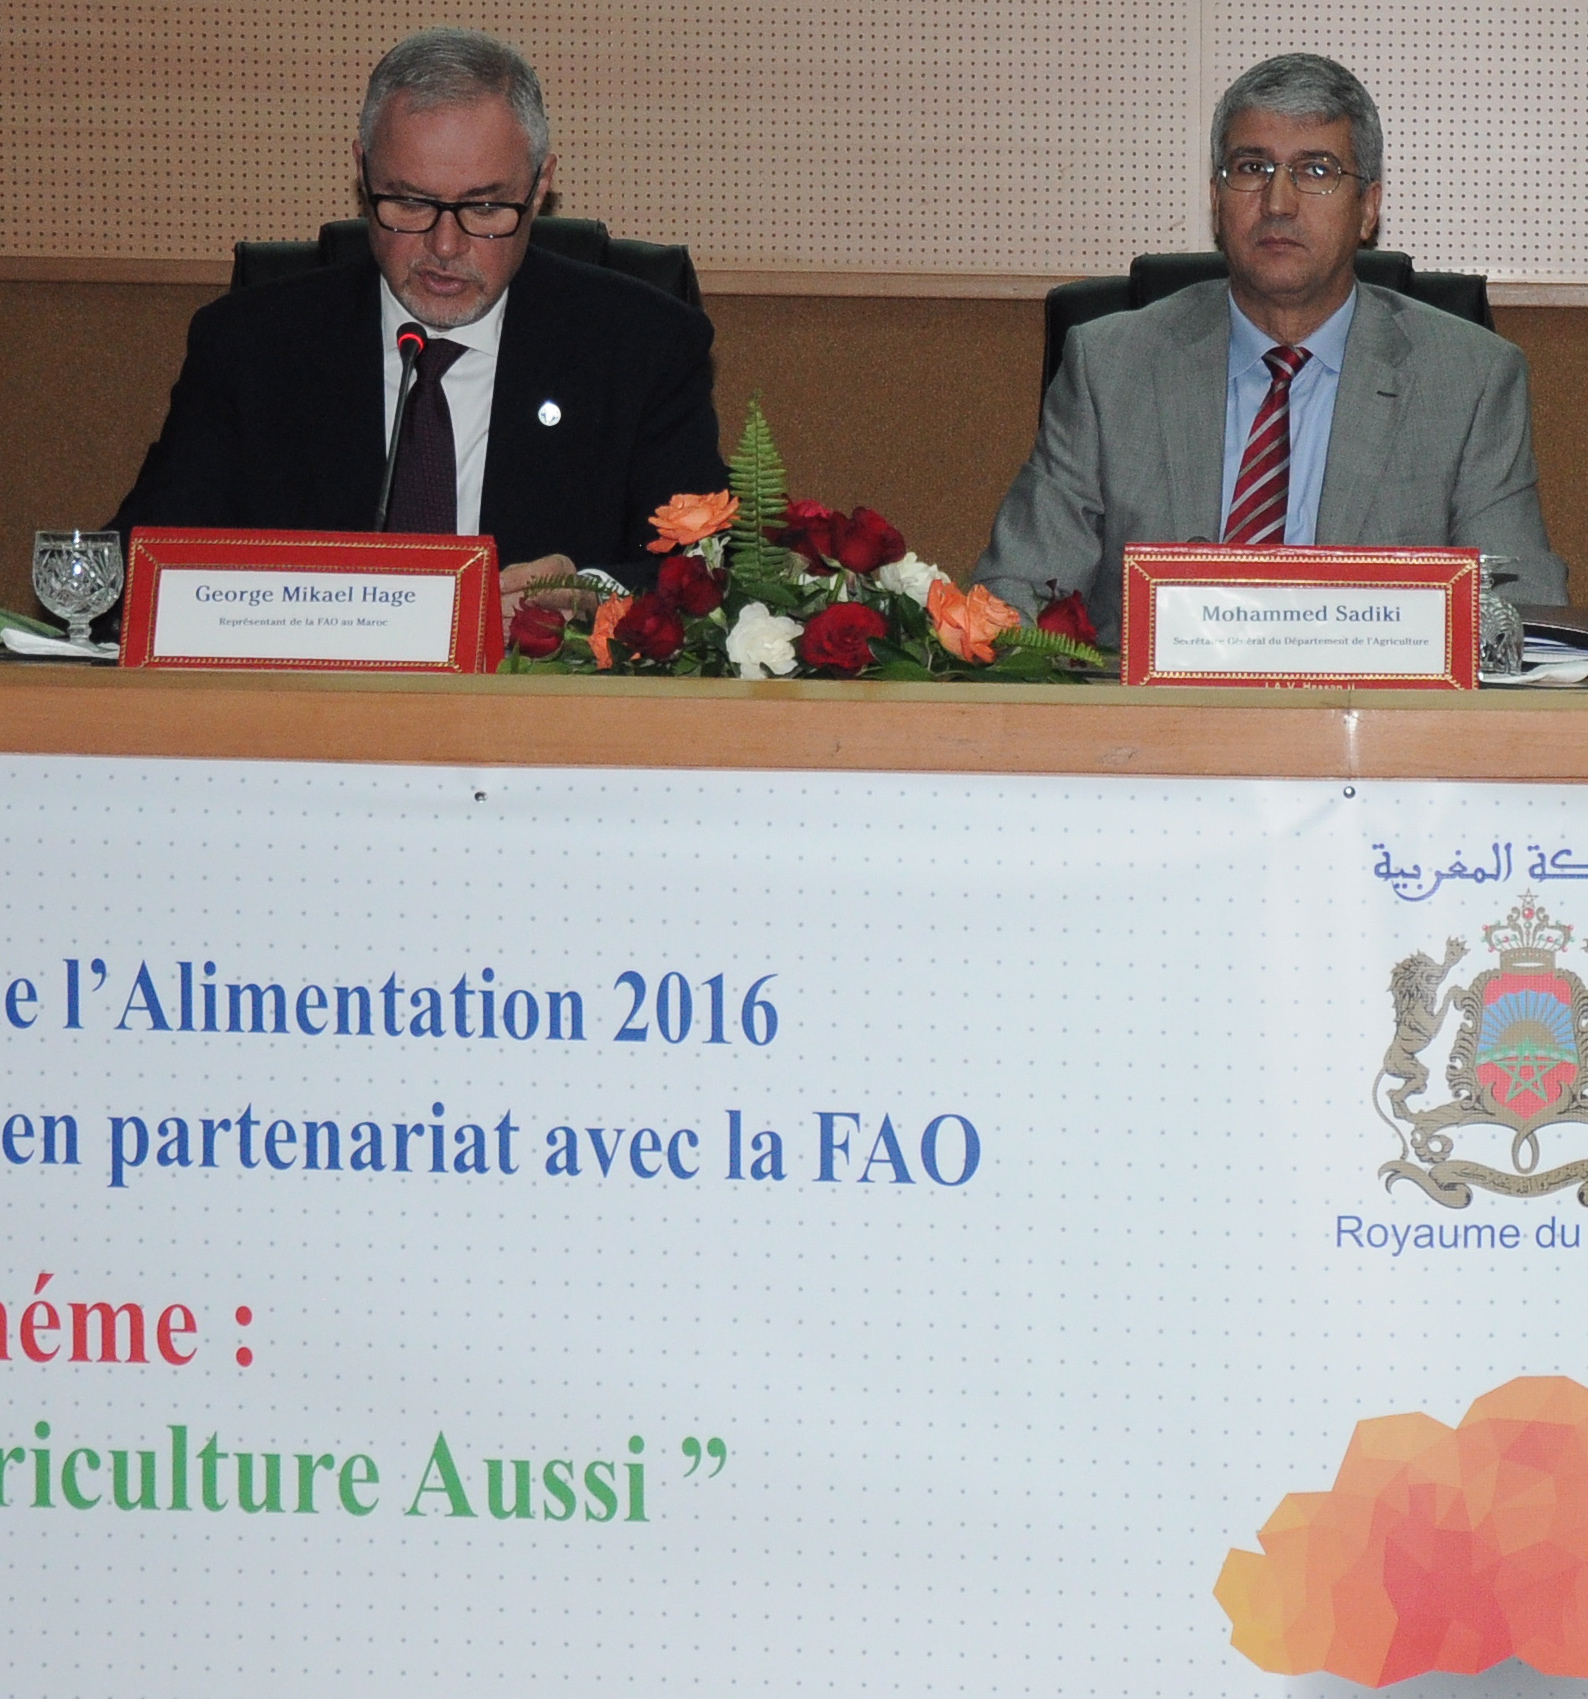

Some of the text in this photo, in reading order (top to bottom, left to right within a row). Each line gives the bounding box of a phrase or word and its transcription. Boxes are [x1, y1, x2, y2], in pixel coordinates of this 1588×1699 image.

[195, 584, 417, 609] George Mikael Hage
[1201, 604, 1402, 623] Mohammed Sadiki
[218, 616, 389, 629] Représentant de la FAO au Maroc
[1172, 635, 1225, 647] Secrétare
[1268, 635, 1282, 647] du
[1283, 634, 1350, 649] Département
[1351, 636, 1365, 647] de
[1366, 636, 1430, 649] l'Agriculture
[1371, 841, 1514, 903] المغربية
[613, 969, 781, 1048] 2016
[1, 1101, 984, 1190] en partenariat avec la FAO
[1335, 1214, 1522, 1256] Royaume
[1534, 1216, 1583, 1250] du
[404, 1432, 651, 1523] Aussi
